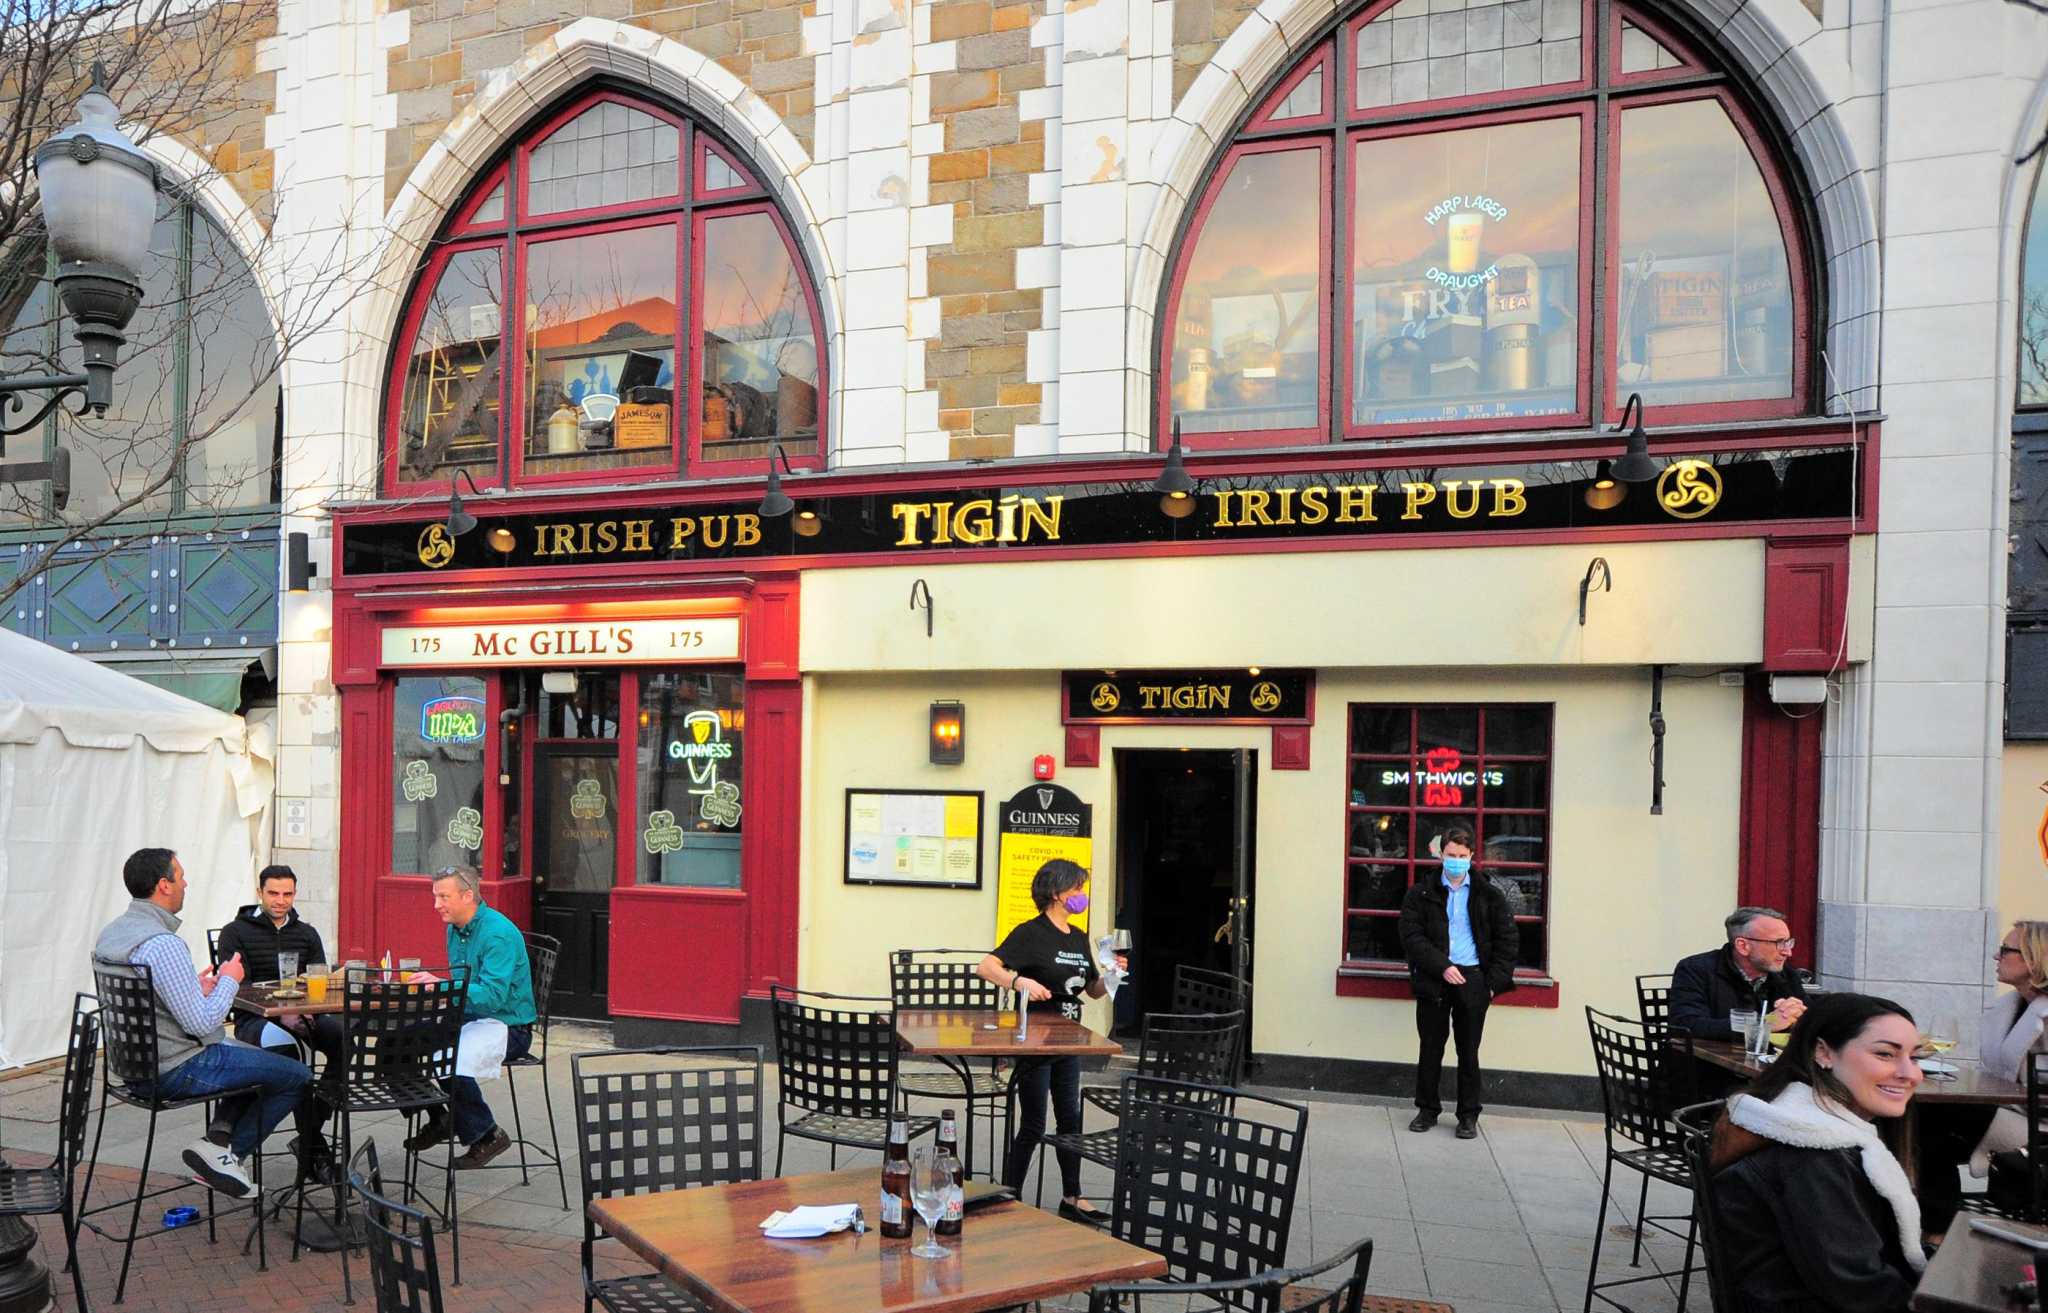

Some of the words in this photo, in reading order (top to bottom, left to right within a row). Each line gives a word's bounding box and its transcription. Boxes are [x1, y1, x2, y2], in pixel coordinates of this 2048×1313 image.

[1424, 196, 1462, 225] HARP
[1465, 195, 1508, 222] LAGER
[1425, 265, 1499, 289] DRAUGHT
[1213, 484, 1378, 528] IRISH
[1401, 478, 1527, 520] PUB
[533, 519, 653, 556] IRISH
[670, 513, 763, 549] PUB
[410, 636, 441, 654] 175
[472, 633, 518, 657] Mc
[529, 627, 634, 656] GILL'S
[669, 630, 704, 648] 175
[669, 741, 732, 758] GUINNESS
[1382, 771, 1504, 786] SMTHWIC'S
[1009, 809, 1080, 826] GUINNESS
